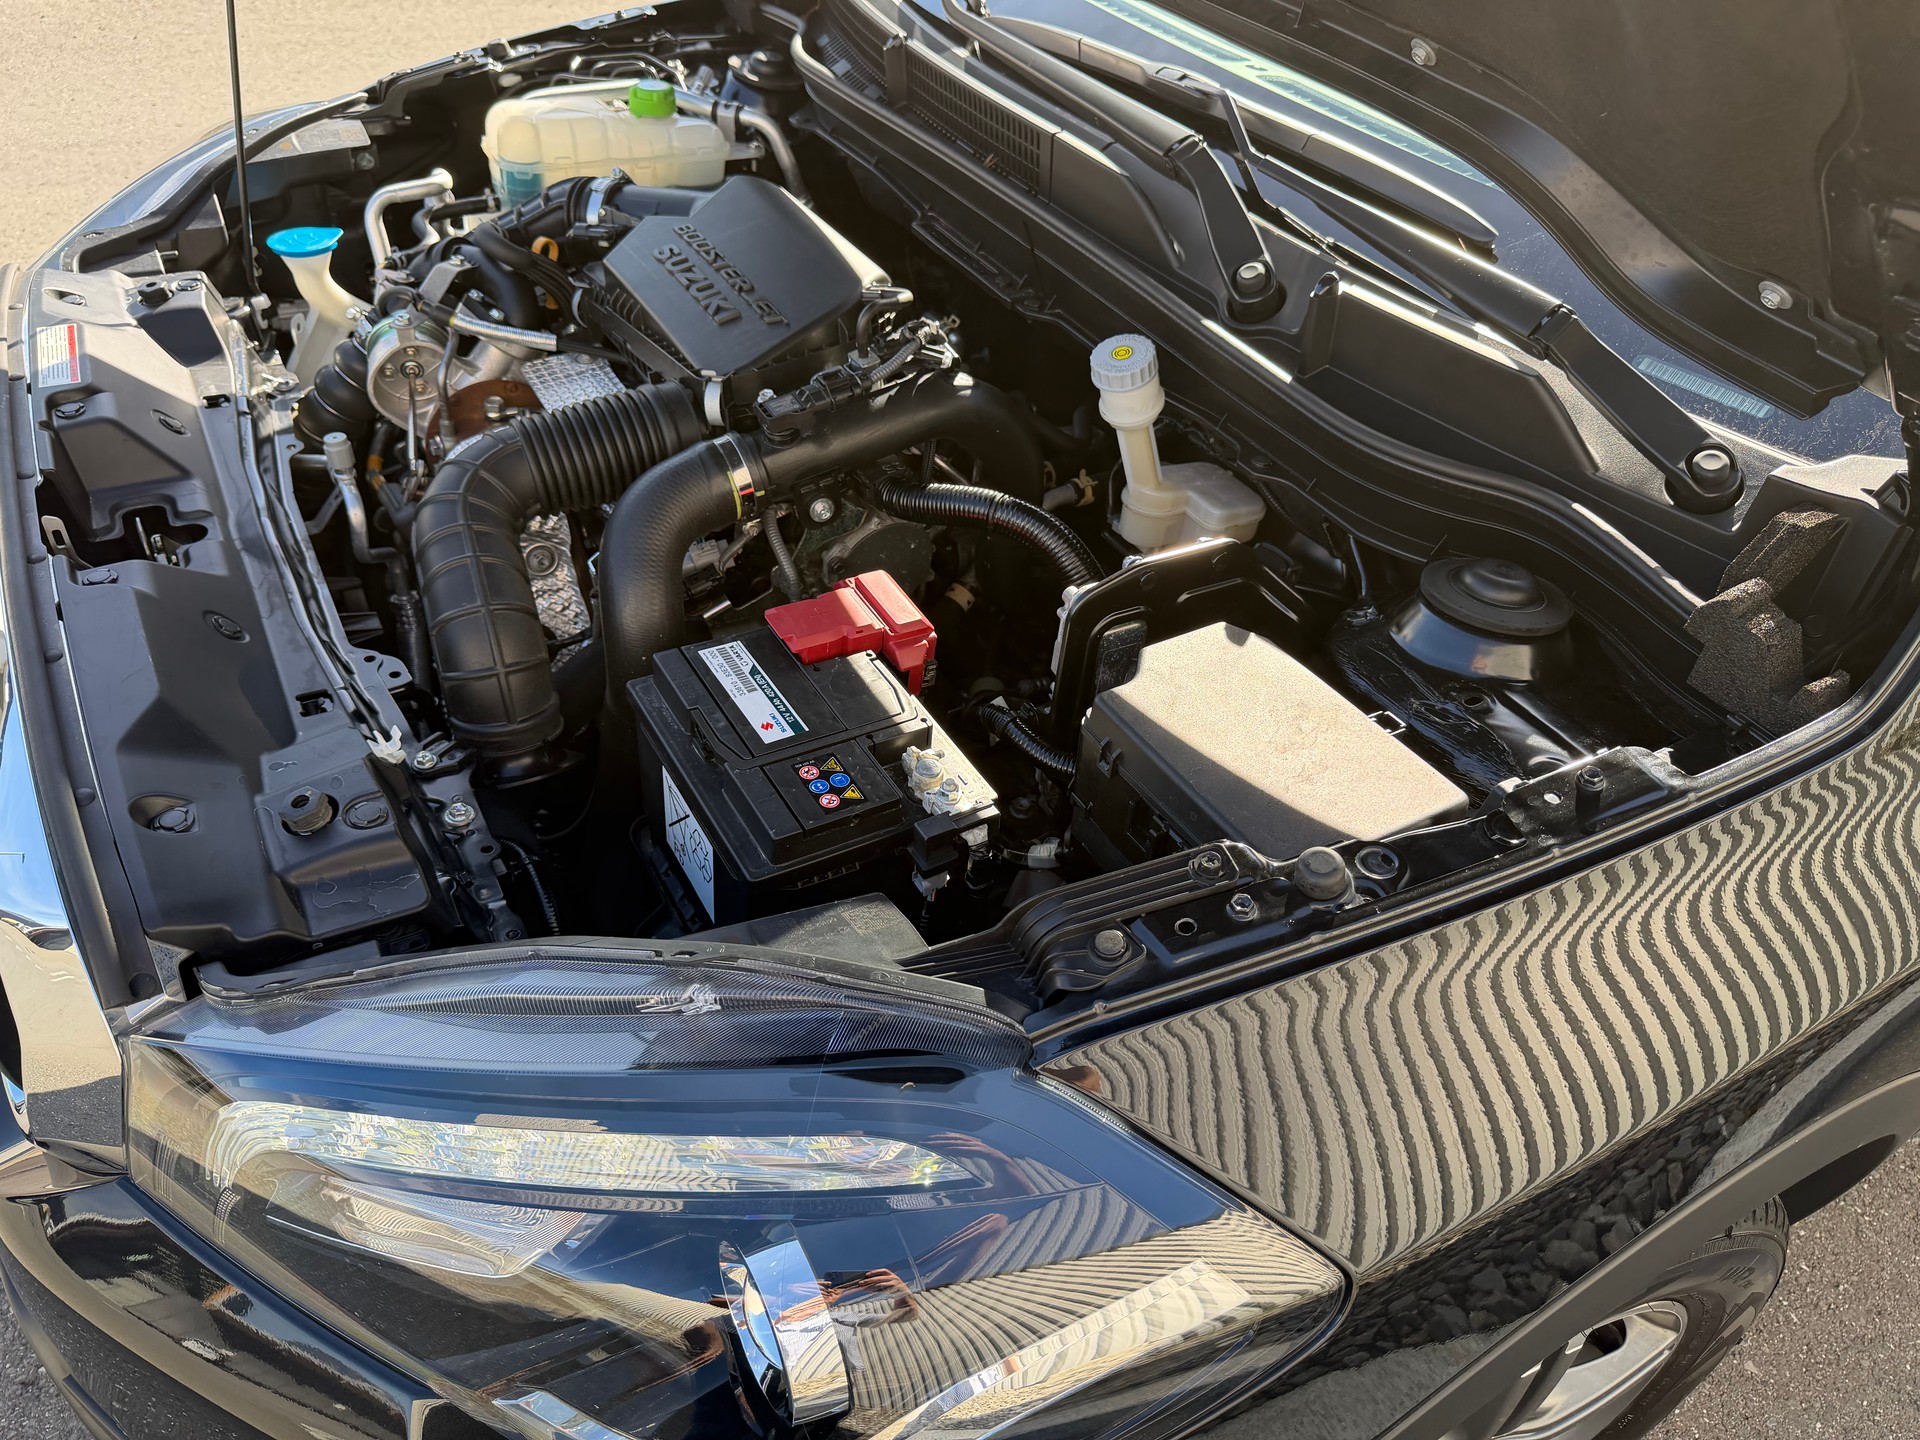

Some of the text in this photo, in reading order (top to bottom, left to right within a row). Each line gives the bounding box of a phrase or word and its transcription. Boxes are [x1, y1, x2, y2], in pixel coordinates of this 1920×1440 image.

[653, 244, 742, 326] SUZUKI
[728, 644, 745, 661] VARTA
[768, 712, 788, 733] SUZUKI
